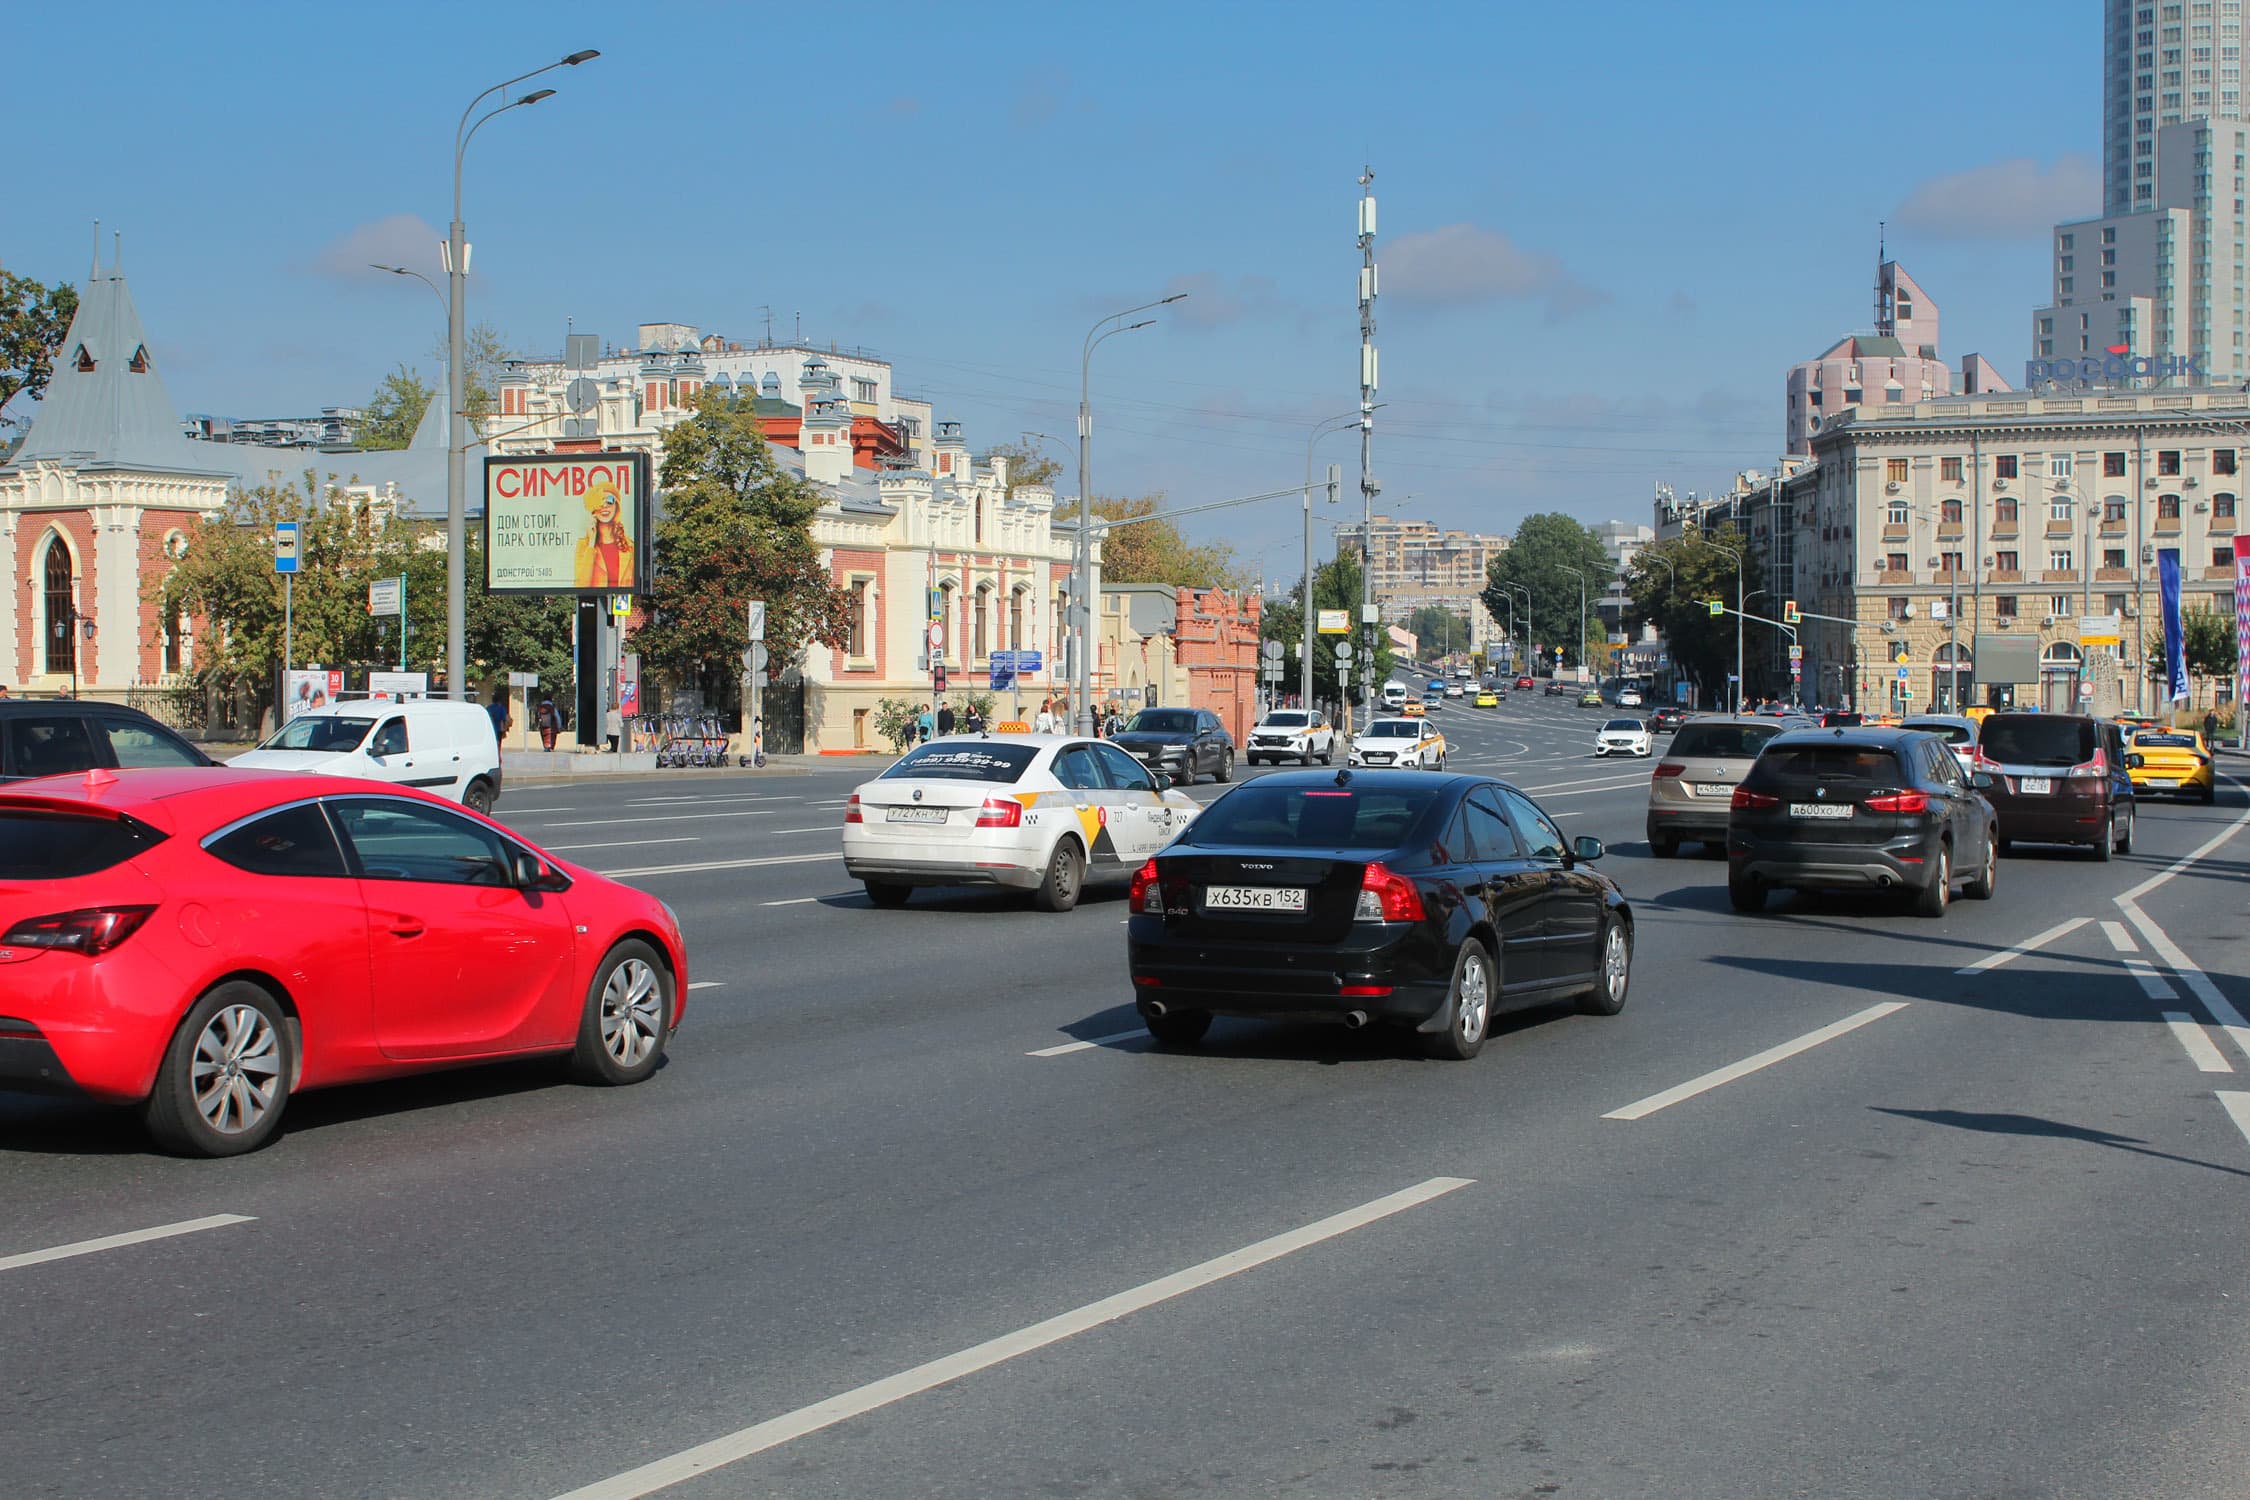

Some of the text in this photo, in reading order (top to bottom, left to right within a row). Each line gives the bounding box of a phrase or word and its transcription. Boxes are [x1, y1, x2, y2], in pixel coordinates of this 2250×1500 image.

[496, 465, 630, 498] СИМВОЛ
[497, 514, 559, 530] ДОМ СТОИТ.
[497, 531, 573, 547] ПАРК ОТКРЫТ.
